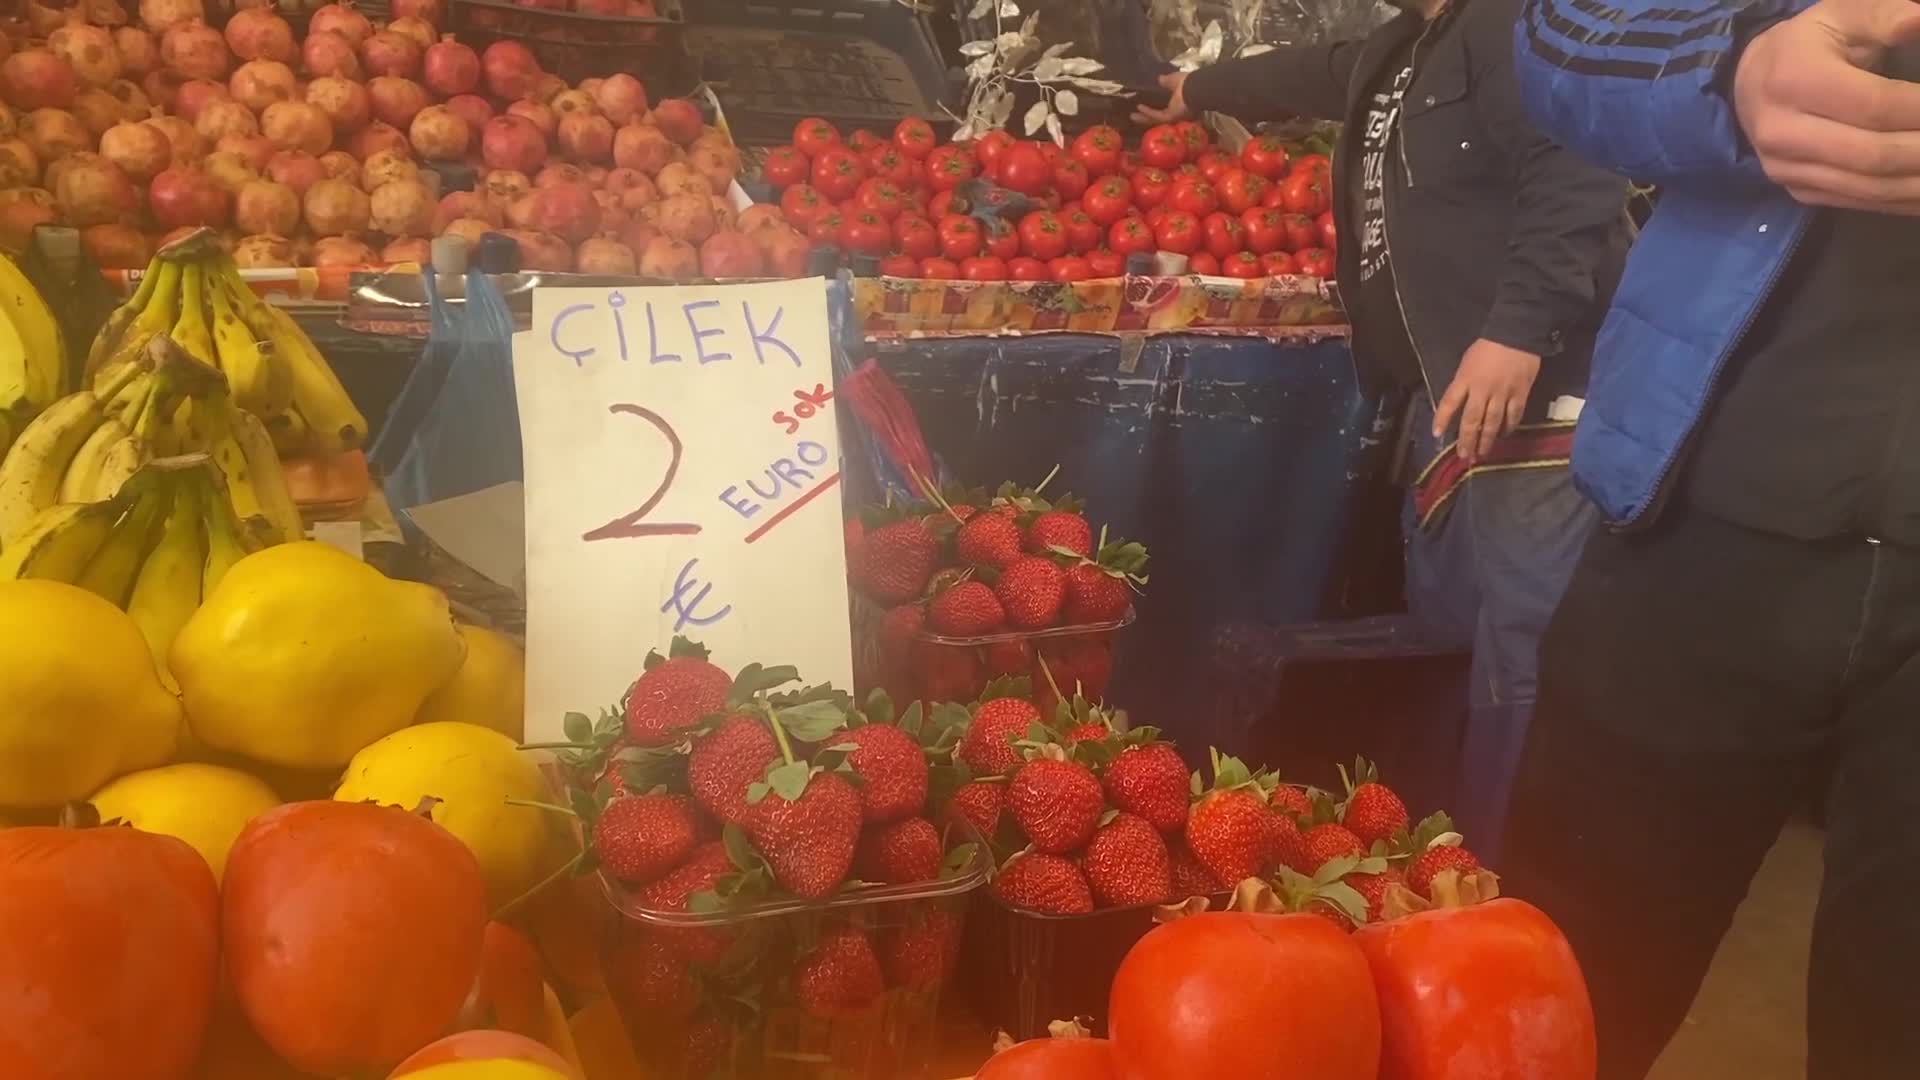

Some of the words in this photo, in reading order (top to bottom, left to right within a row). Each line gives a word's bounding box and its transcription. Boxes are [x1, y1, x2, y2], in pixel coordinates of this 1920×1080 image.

[551, 290, 802, 367] ÇİLEK
[582, 403, 703, 542] 2
[718, 441, 828, 519] EURO
[660, 558, 732, 632] €
